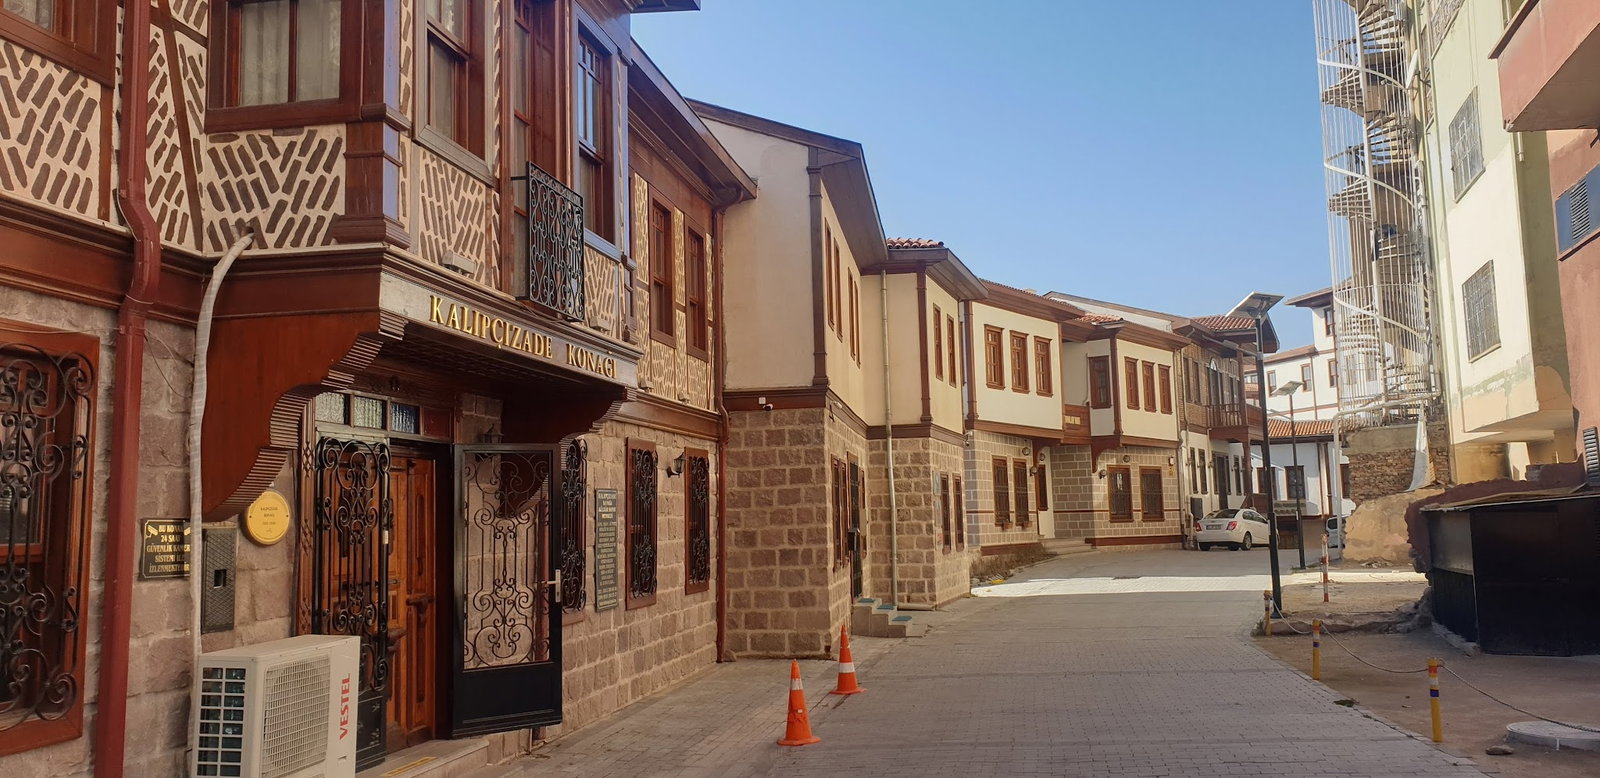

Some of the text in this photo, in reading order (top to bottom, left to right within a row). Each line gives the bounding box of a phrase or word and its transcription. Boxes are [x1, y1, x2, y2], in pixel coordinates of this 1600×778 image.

[429, 295, 618, 379] KALIPÇIZADE KONAĞI
[158, 524, 166, 532] BU
[173, 544, 191, 552] KAMER
[339, 673, 351, 740] VESTEL
